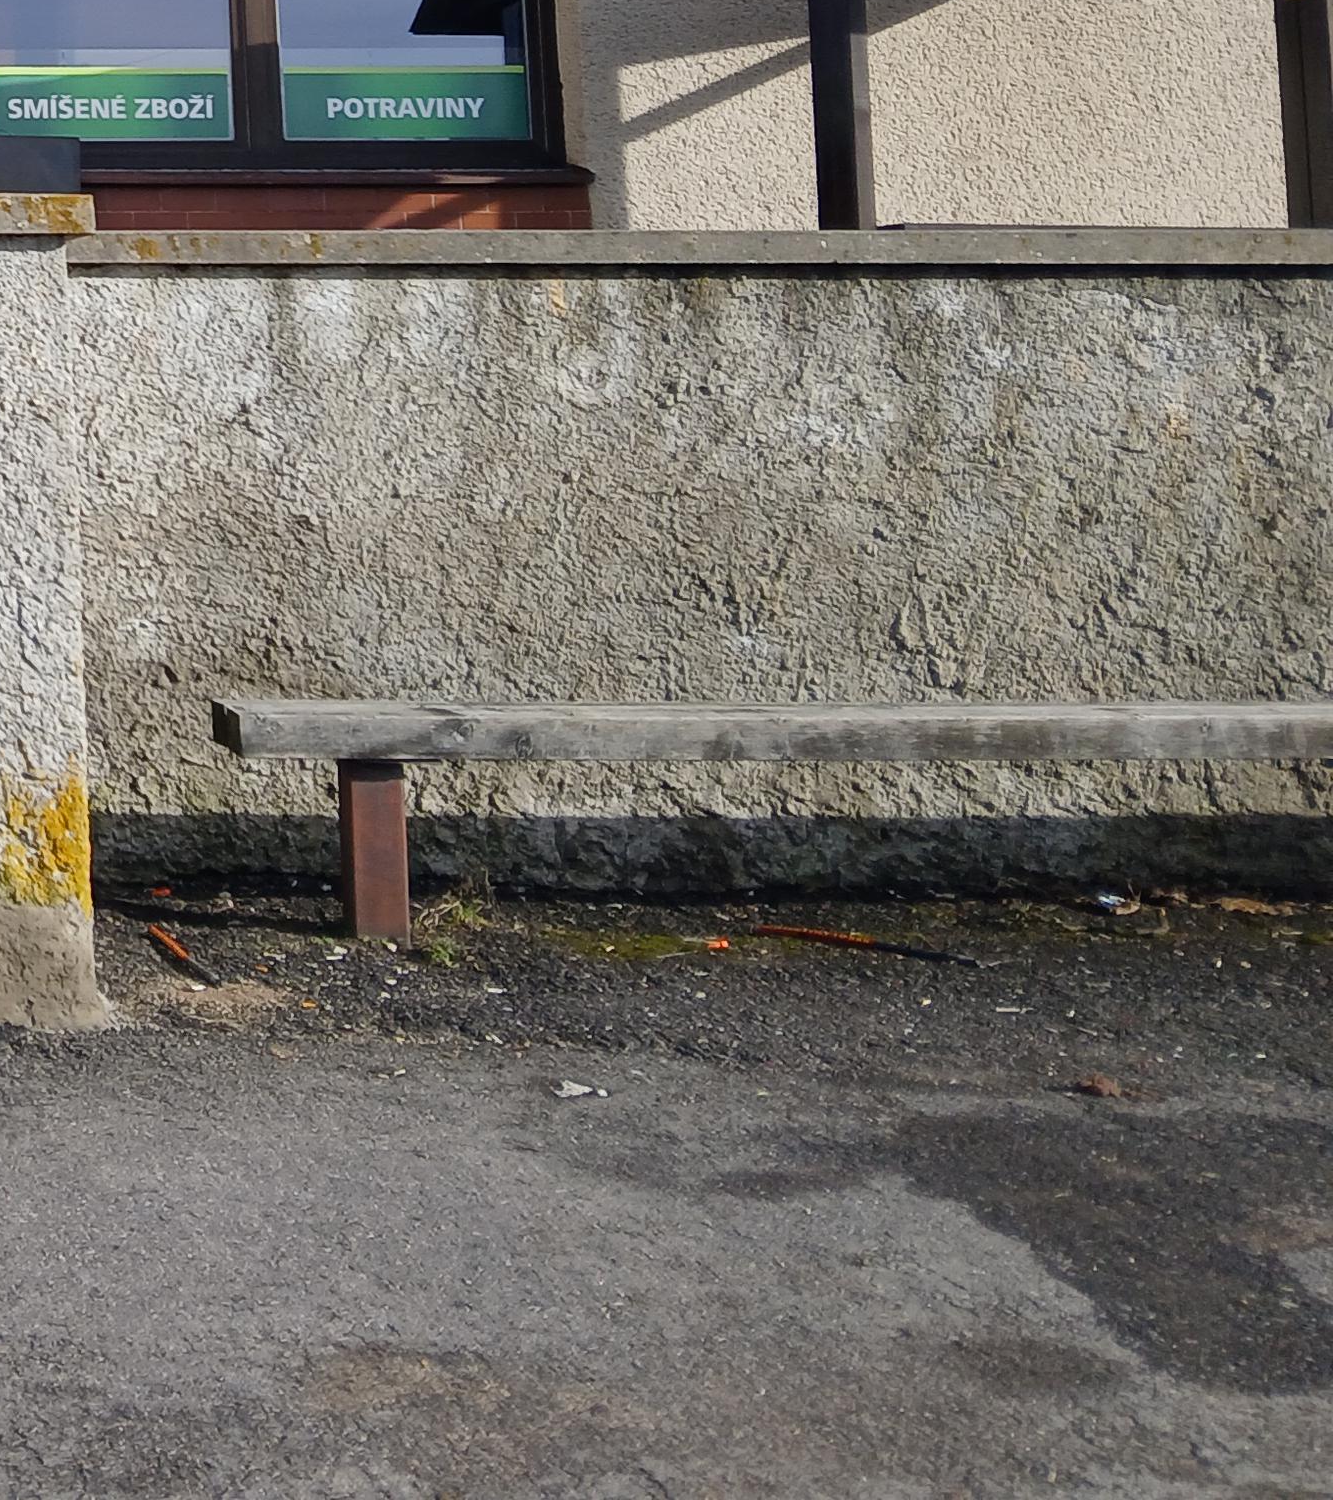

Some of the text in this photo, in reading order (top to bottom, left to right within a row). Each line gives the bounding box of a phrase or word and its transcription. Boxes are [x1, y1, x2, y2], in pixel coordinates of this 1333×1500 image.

[7, 94, 214, 120] SMÍŠENÉ ZBOŽÍ
[326, 97, 484, 119] POTRAVINY
